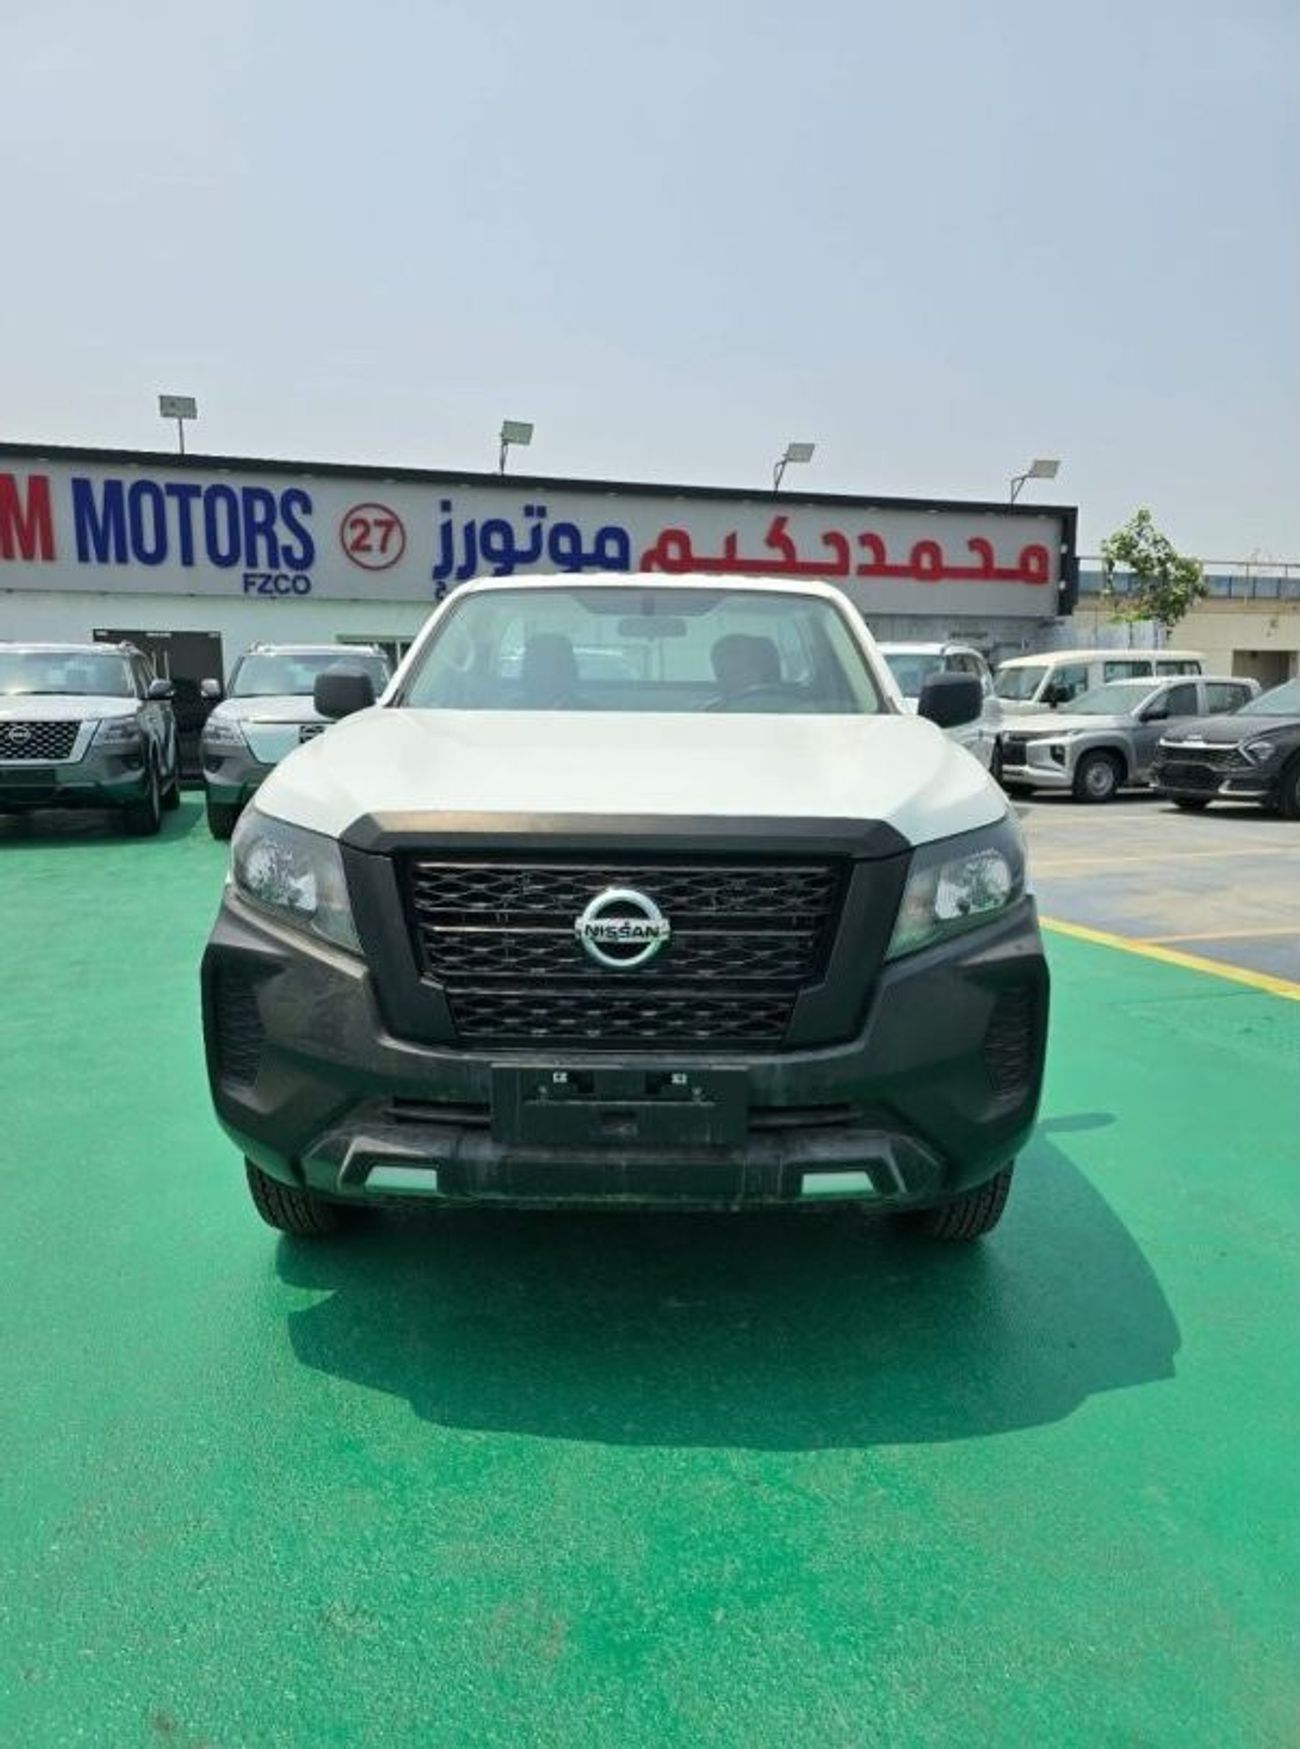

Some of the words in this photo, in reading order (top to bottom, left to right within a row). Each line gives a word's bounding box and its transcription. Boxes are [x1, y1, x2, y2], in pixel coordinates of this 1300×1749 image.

[71, 477, 315, 571] MOTORS
[350, 518, 396, 554] 27
[433, 500, 630, 579] موتورز
[857, 533, 1049, 585] محمد
[242, 573, 312, 595] FZCO
[585, 924, 660, 938] NISSAN
